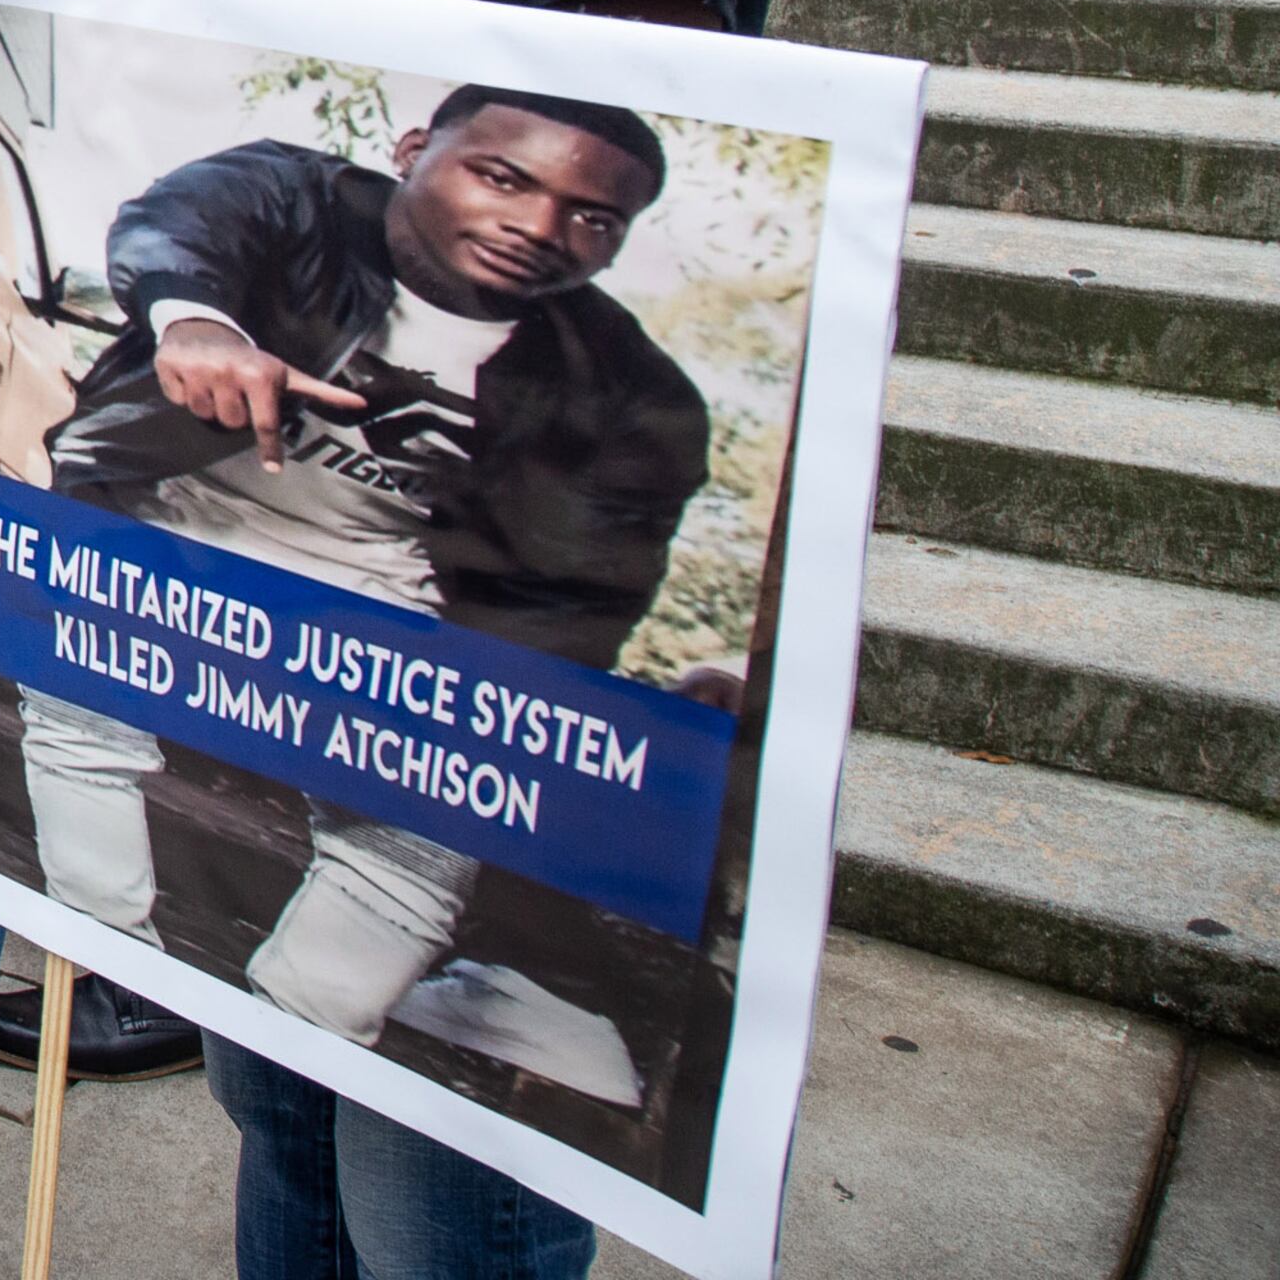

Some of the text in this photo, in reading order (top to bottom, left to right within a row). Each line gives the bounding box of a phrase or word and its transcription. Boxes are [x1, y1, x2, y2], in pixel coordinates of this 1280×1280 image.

[48, 536, 273, 660] MILITARIZED
[285, 623, 460, 724] JUSTICE
[470, 680, 648, 791] SYSTEM
[54, 611, 541, 833] KILLED JIMMY ATCHISON
